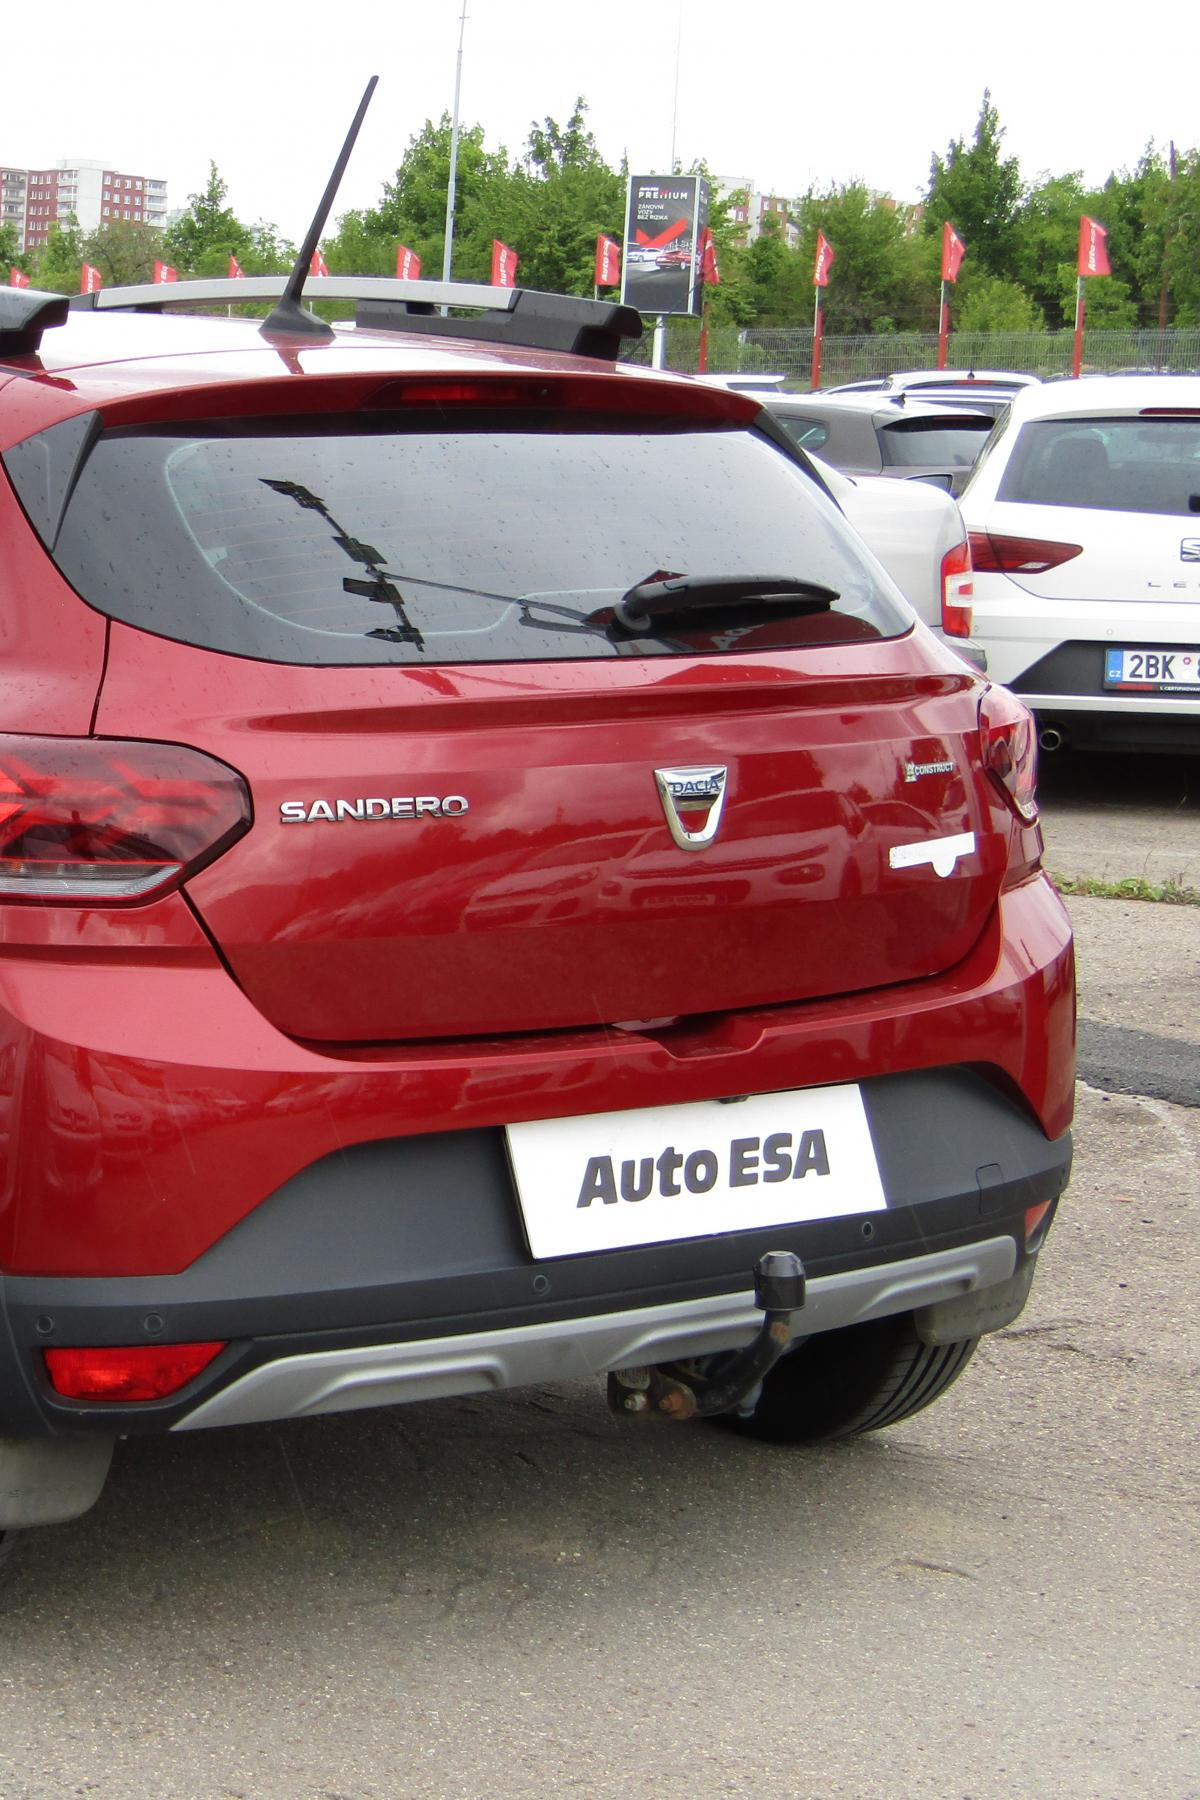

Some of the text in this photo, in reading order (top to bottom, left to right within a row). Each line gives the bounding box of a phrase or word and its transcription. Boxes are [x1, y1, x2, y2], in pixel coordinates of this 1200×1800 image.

[1147, 581, 1200, 589] LE
[1109, 670, 1121, 678] CZ
[1128, 654, 1176, 679] 2BK
[914, 761, 955, 776] CONSTRUCT
[672, 779, 720, 793] DACIA
[280, 795, 470, 824] SANDERO
[576, 1128, 831, 1209] Auto ESA
